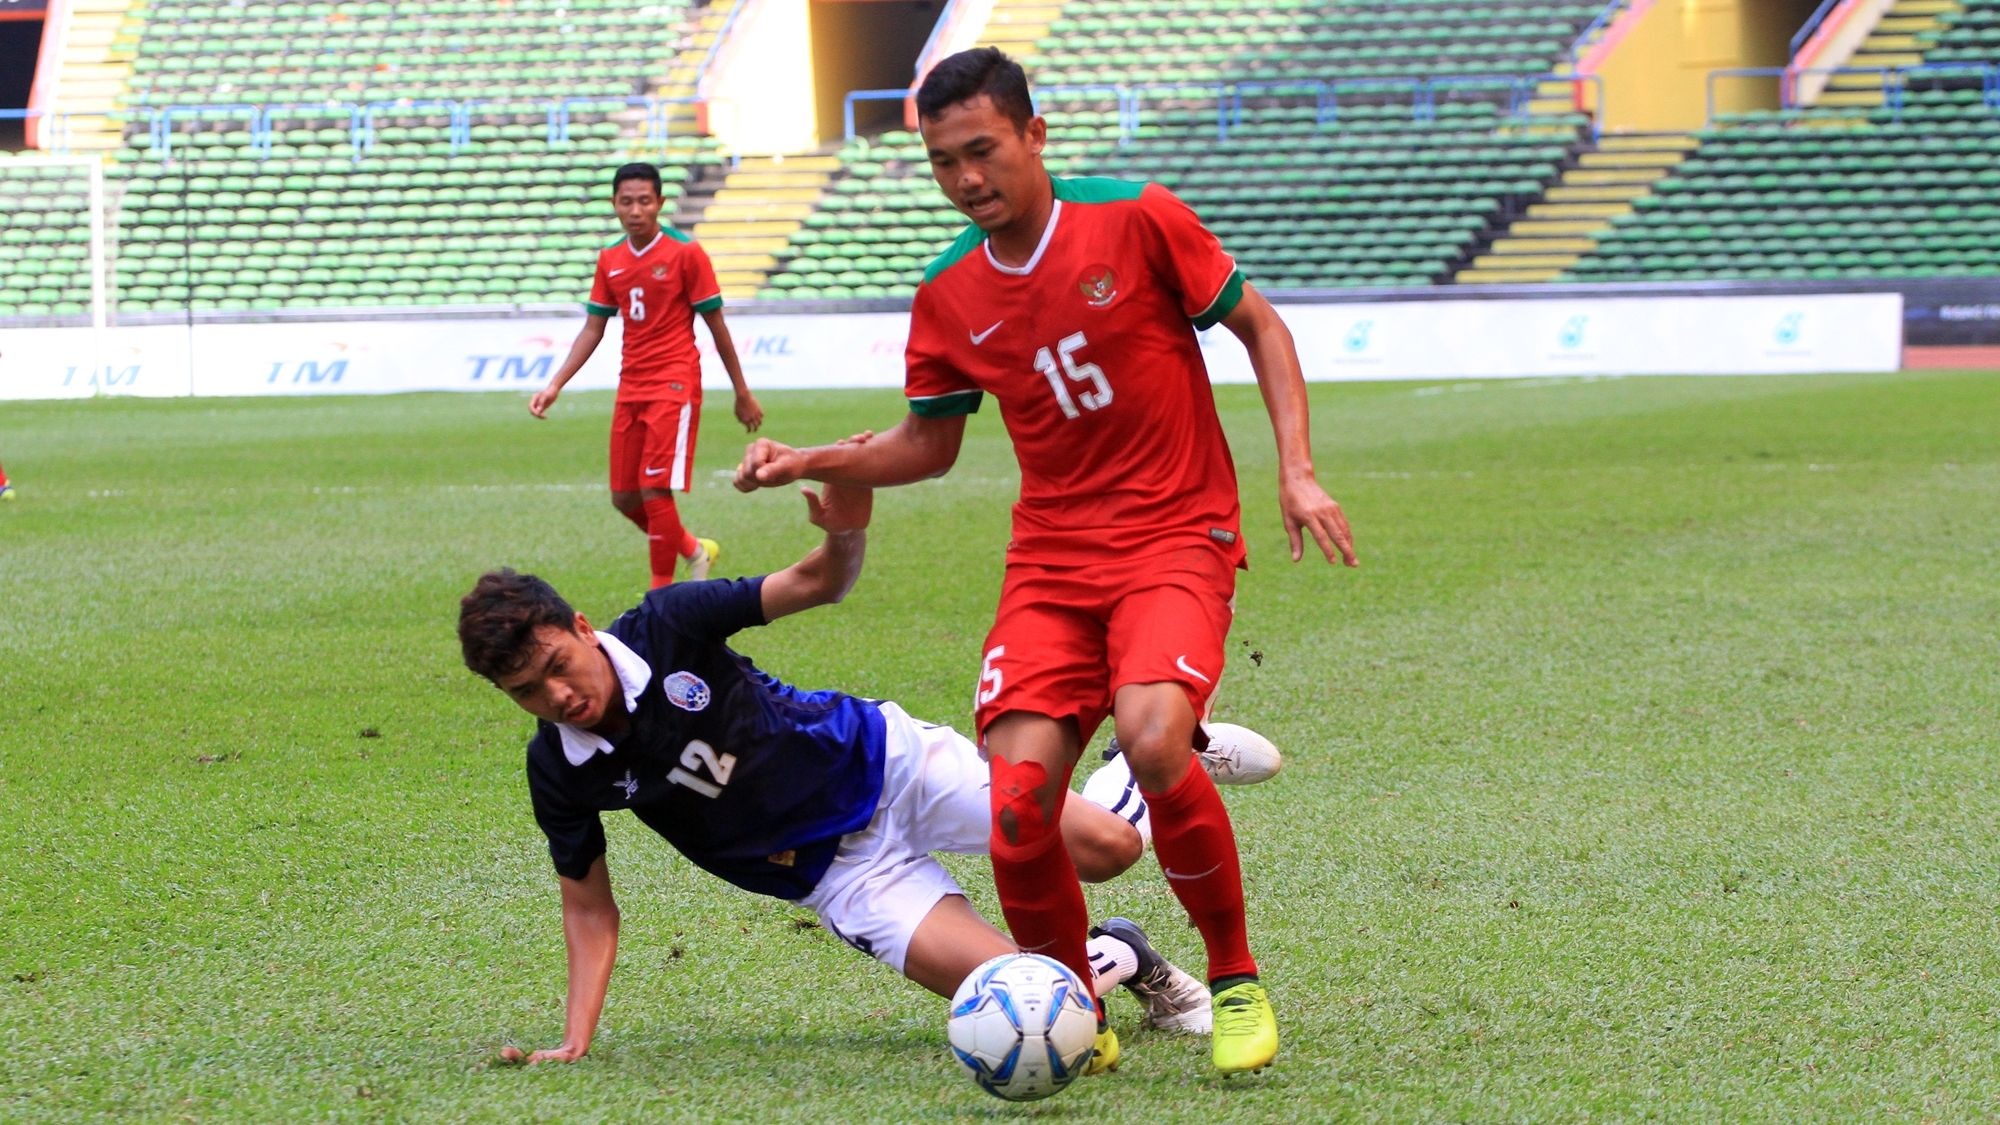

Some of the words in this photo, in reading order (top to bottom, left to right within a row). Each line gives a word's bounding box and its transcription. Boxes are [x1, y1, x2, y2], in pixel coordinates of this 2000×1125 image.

[629, 286, 646, 321] 6
[264, 359, 350, 383] TM
[465, 354, 554, 379] TM
[1033, 330, 1114, 420] 15
[665, 738, 737, 799] 12
